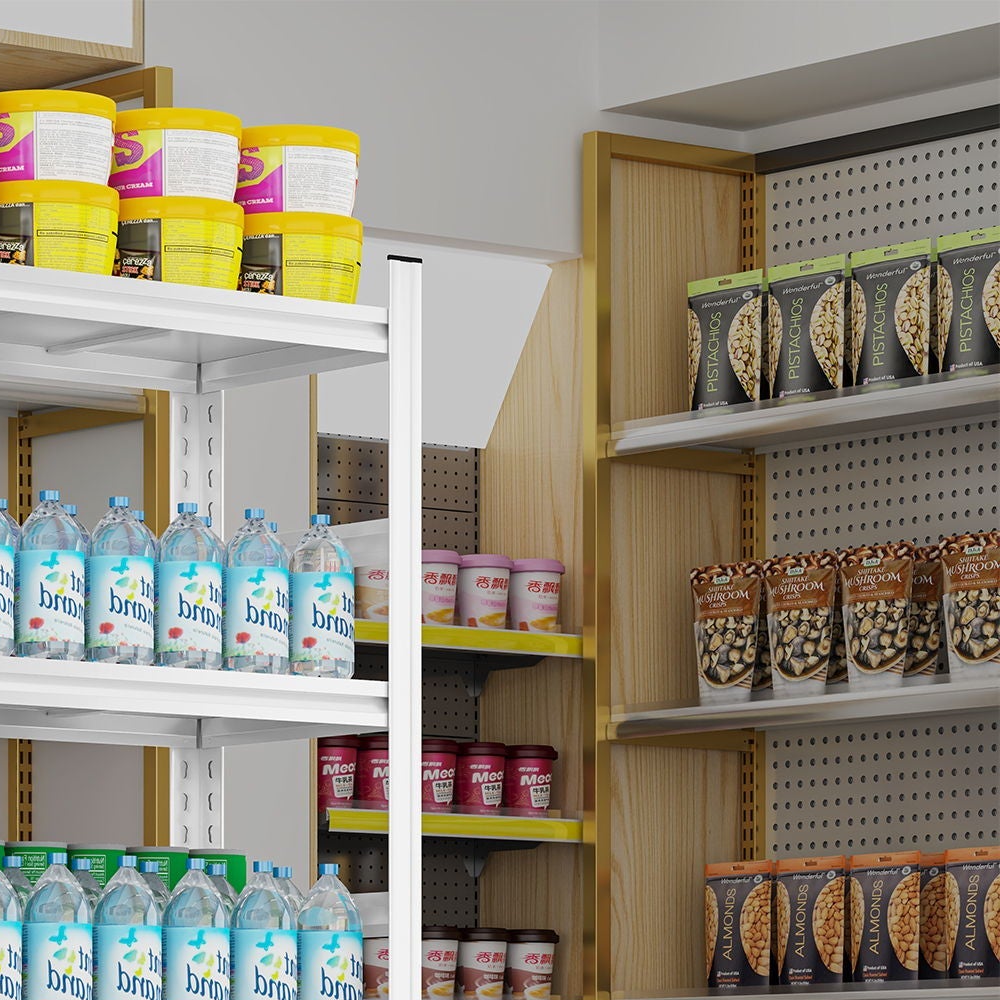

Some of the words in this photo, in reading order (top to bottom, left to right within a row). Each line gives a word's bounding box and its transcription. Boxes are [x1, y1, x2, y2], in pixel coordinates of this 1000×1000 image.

[126, 182, 153, 190] CREAM
[247, 198, 273, 206] CREAM
[953, 251, 997, 264] Wonderful
[866, 267, 909, 280] Wonderful
[782, 282, 823, 294] Wonderful
[702, 297, 741, 308] Wonderful
[960, 267, 976, 352] PISTACHIOS
[873, 282, 888, 366] PISTACHIOS
[789, 297, 804, 380] PISTACHIOS
[707, 311, 722, 393] PISTACHIOS
[945, 560, 1000, 576] MUSHROOM
[845, 572, 902, 588] MUSHROOM
[769, 581, 825, 597] MUSHROOM
[695, 590, 750, 606] MUSHROOM
[867, 867, 901, 876] Wonderful
[963, 862, 997, 871] Wonderful
[721, 876, 752, 884] Wonderful
[793, 872, 825, 880] Wonderful
[869, 880, 884, 954] ALMONDS
[965, 874, 980, 950] ALMONDS
[723, 888, 736, 960] ALMONDS
[795, 884, 809, 957] ALMONDS
